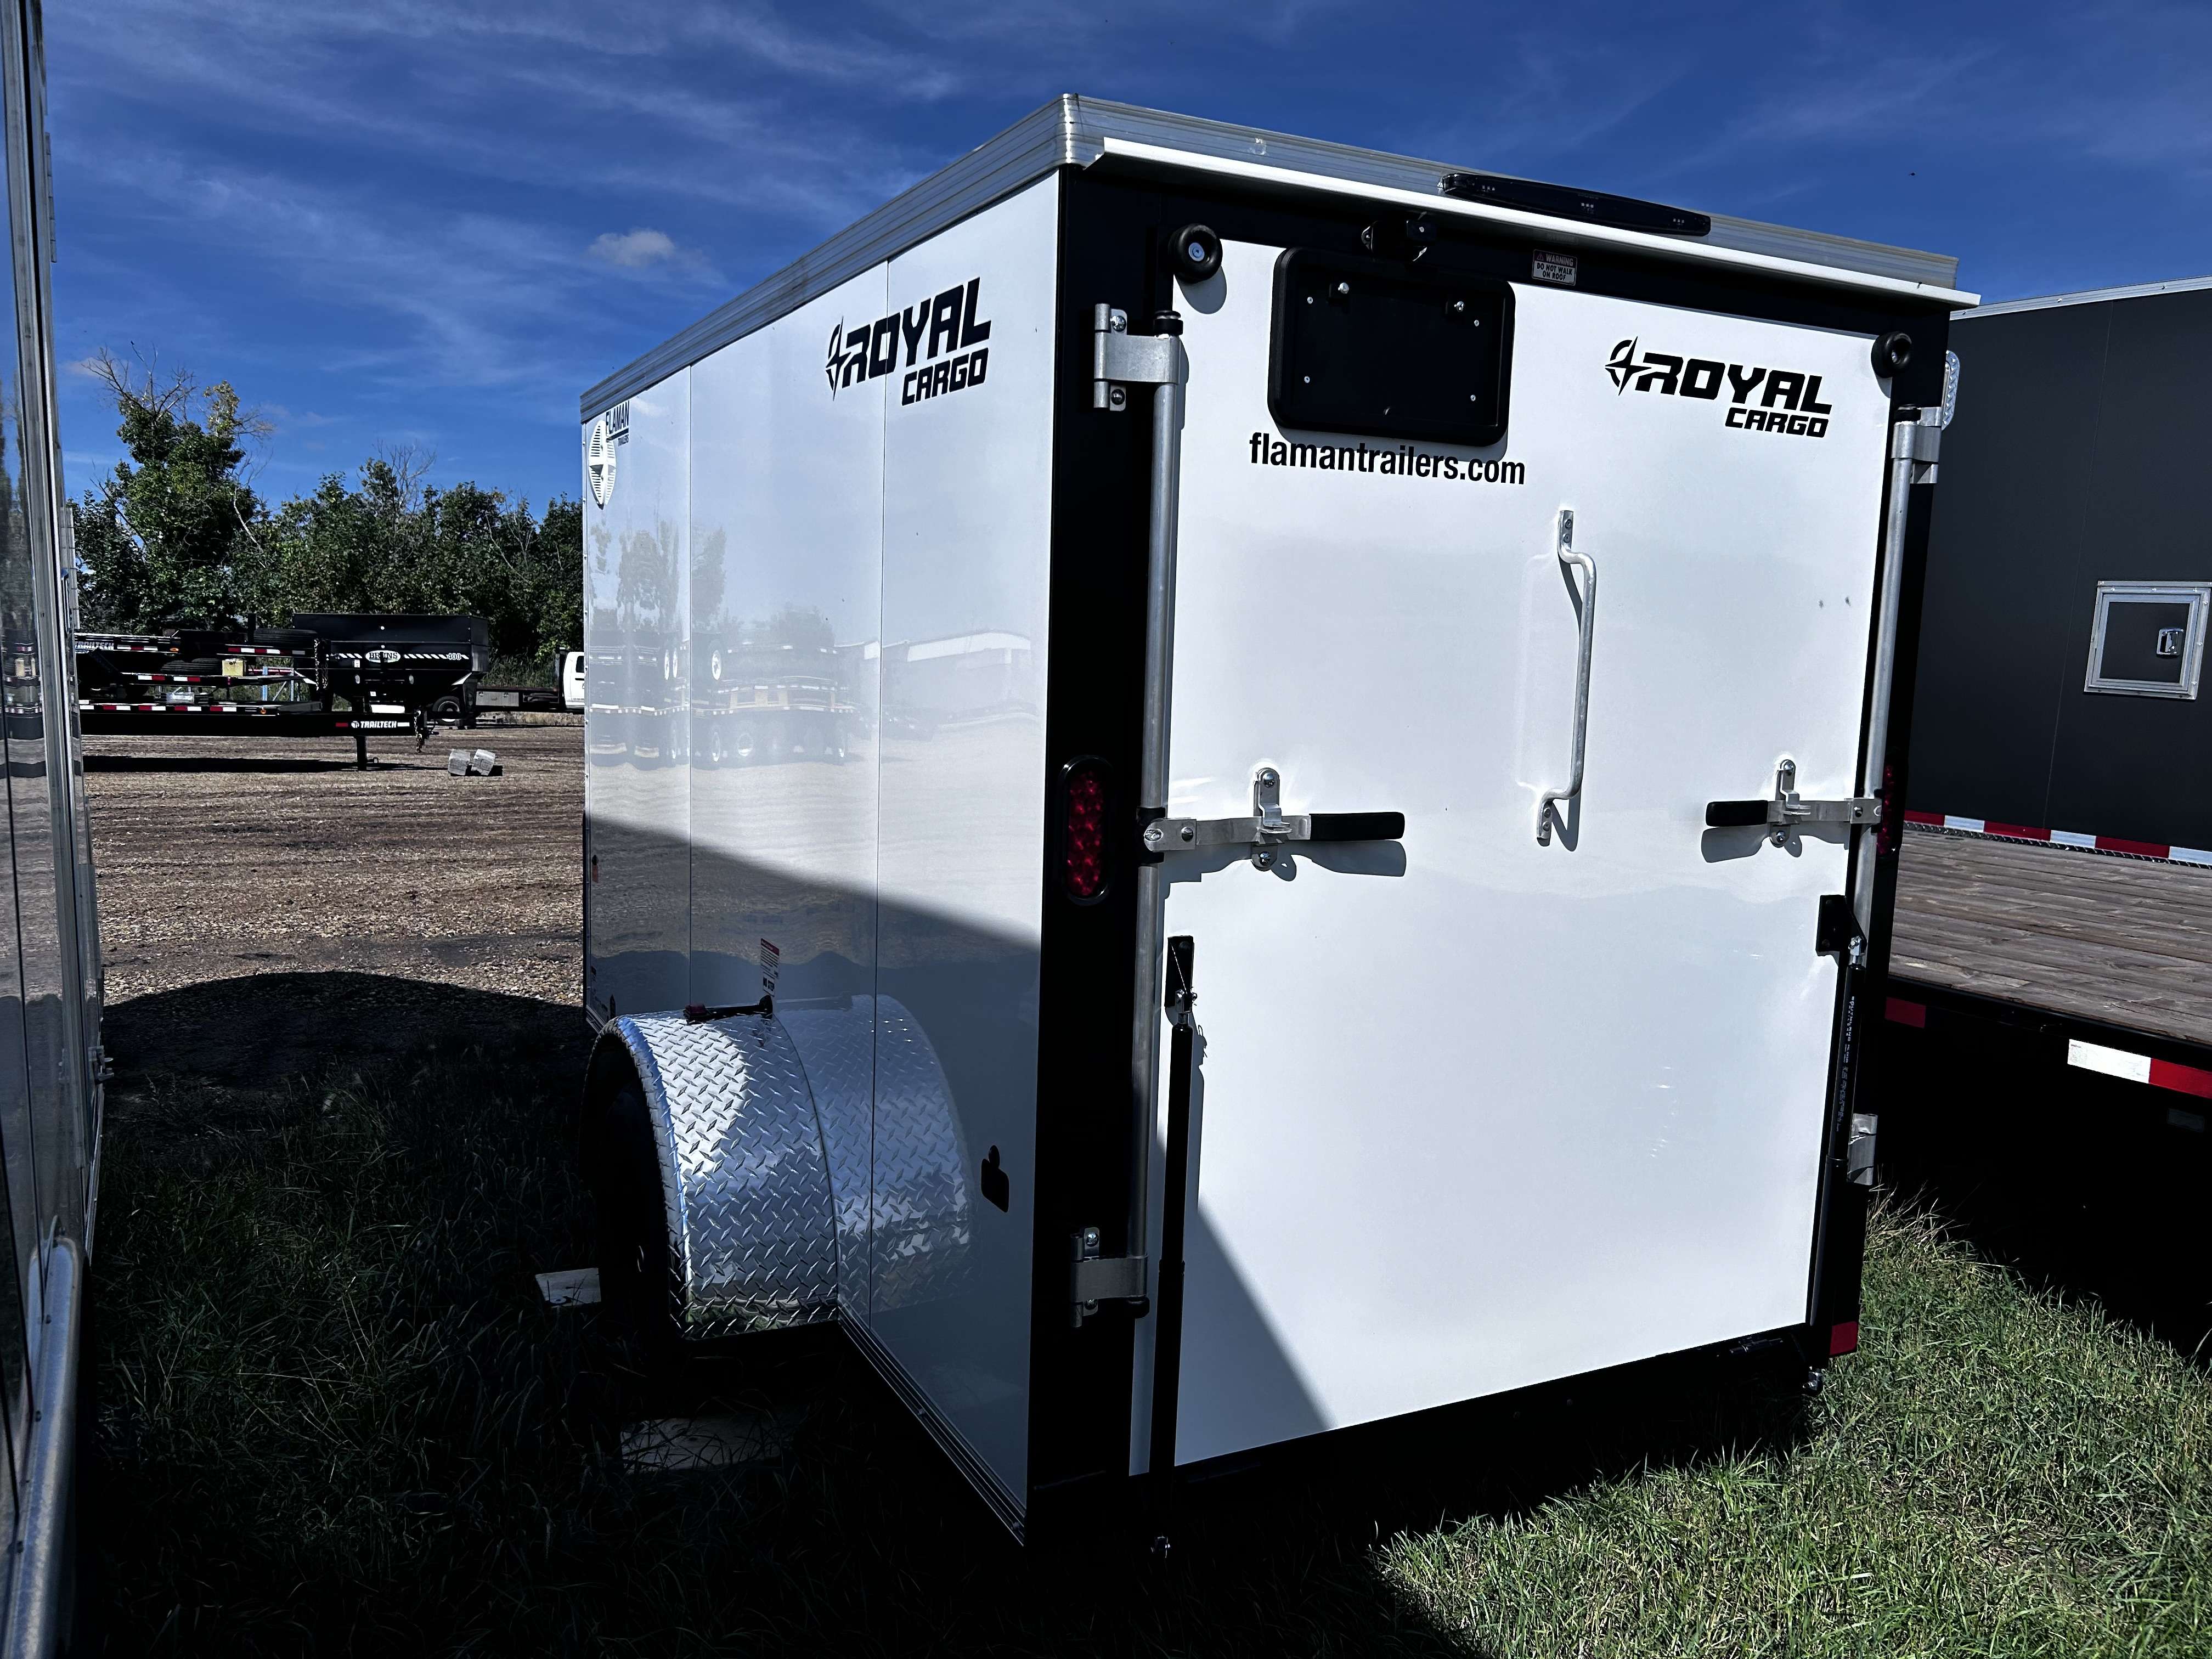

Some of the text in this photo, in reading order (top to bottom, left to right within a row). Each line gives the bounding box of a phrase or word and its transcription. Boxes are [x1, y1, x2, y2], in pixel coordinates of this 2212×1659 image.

[1546, 253, 1573, 267] WARNING
[1546, 264, 1556, 273] NOT
[1558, 267, 1572, 275] WALK
[1552, 273, 1566, 281] ROOF
[842, 276, 991, 388] ROYAL
[901, 347, 989, 406] CARGO
[1635, 352, 1832, 415] ROYAL
[606, 400, 630, 436] FLAMAN
[1725, 407, 1829, 438] CARGO
[1249, 432, 1525, 485] flamantrailers.com
